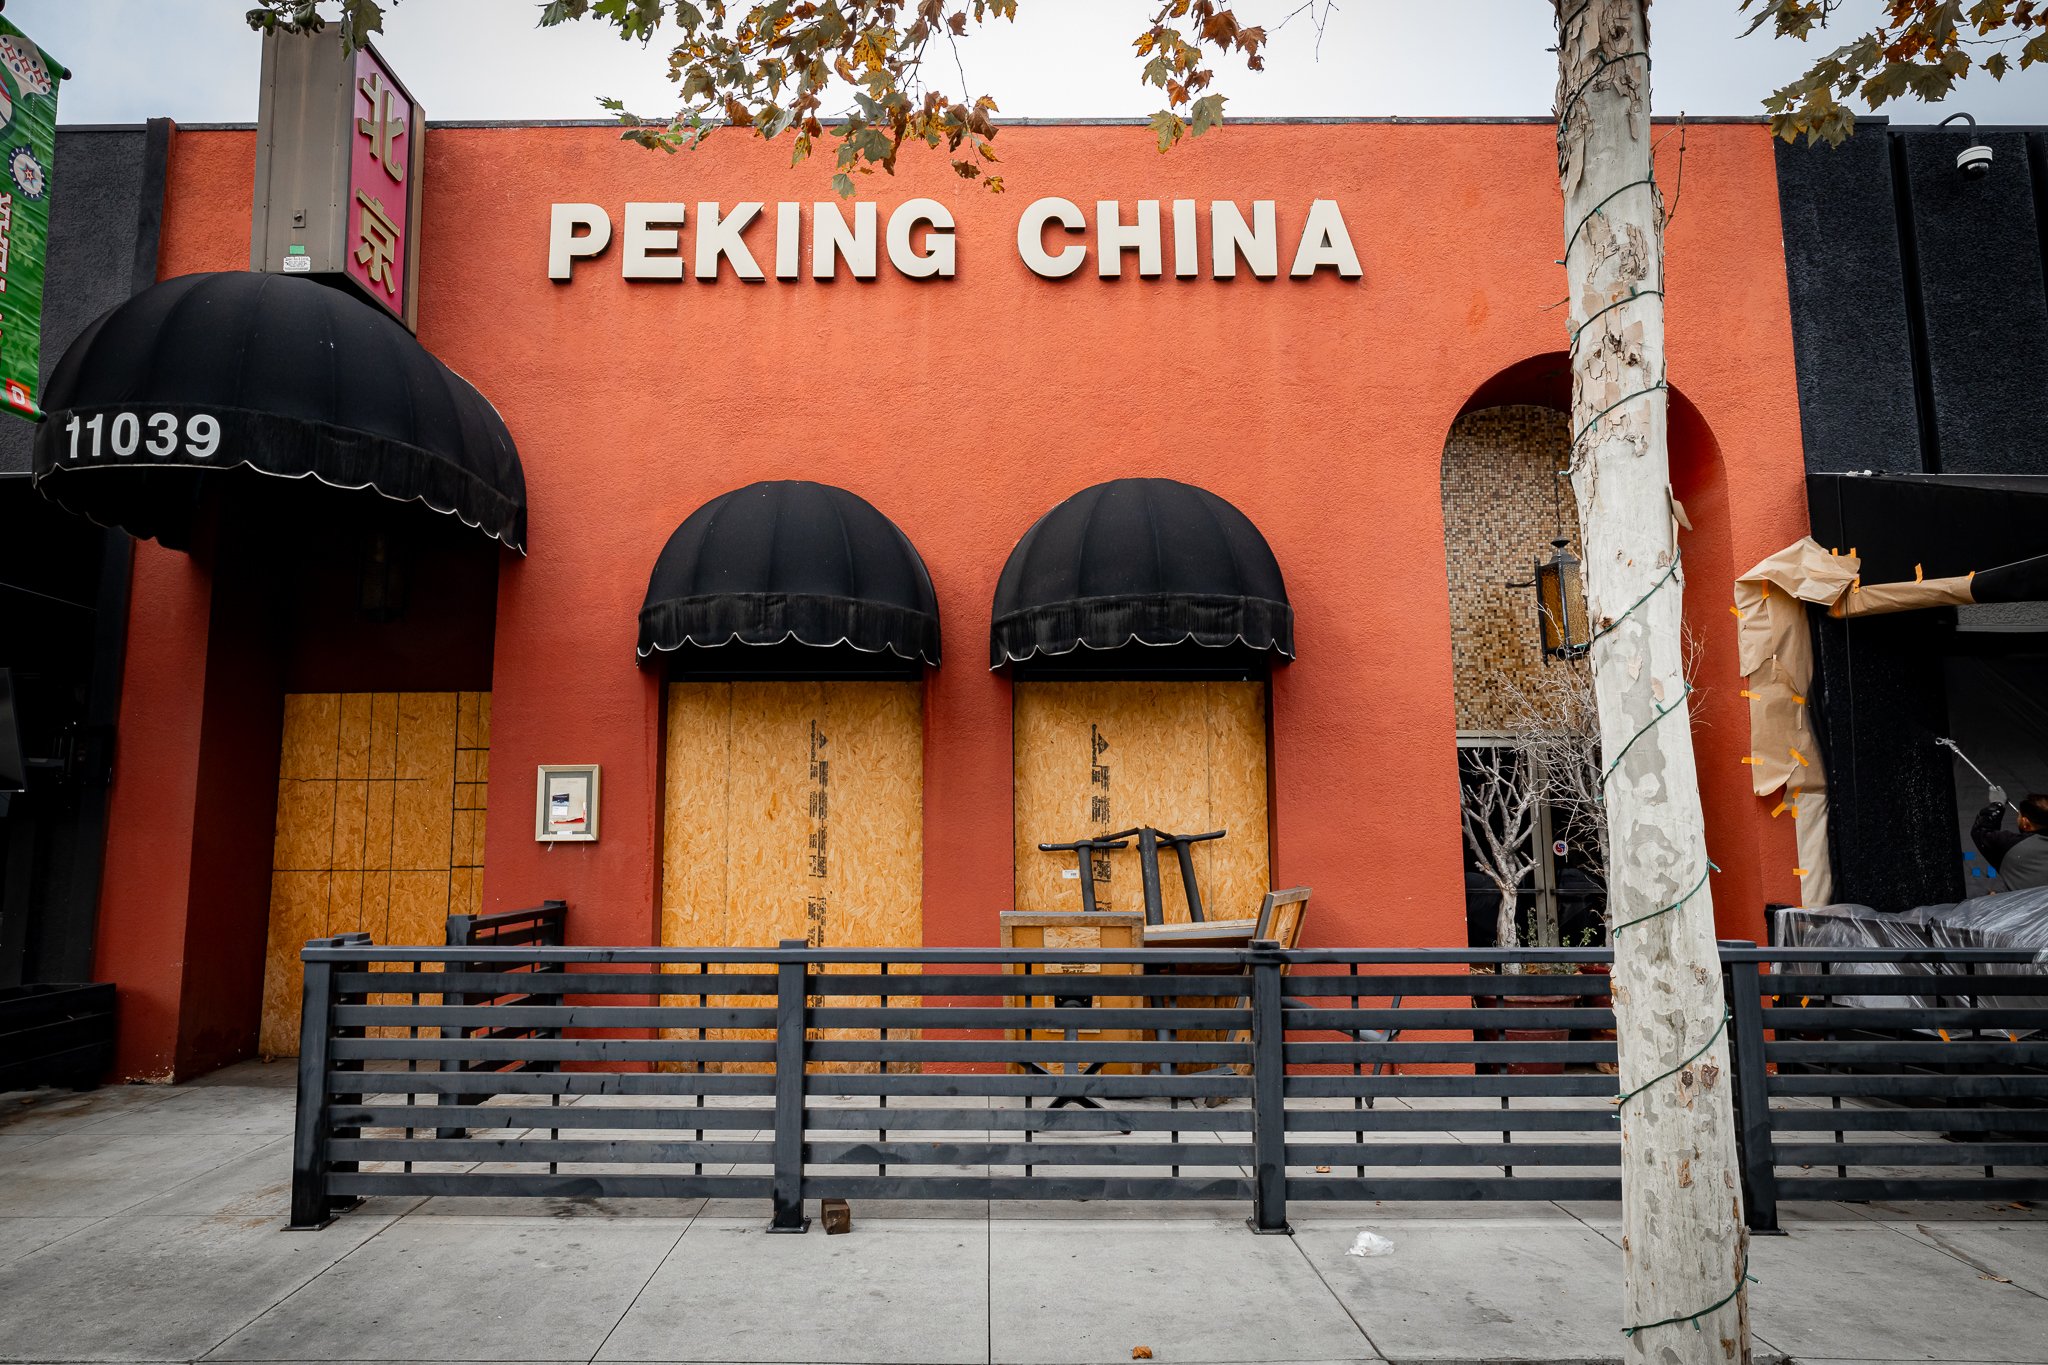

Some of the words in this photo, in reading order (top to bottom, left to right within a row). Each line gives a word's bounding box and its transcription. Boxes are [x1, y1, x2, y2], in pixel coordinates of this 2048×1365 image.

[354, 72, 404, 293] 北京
[548, 198, 957, 282] PEKING
[1017, 196, 1363, 280] CHINA
[66, 412, 221, 459] 11039
